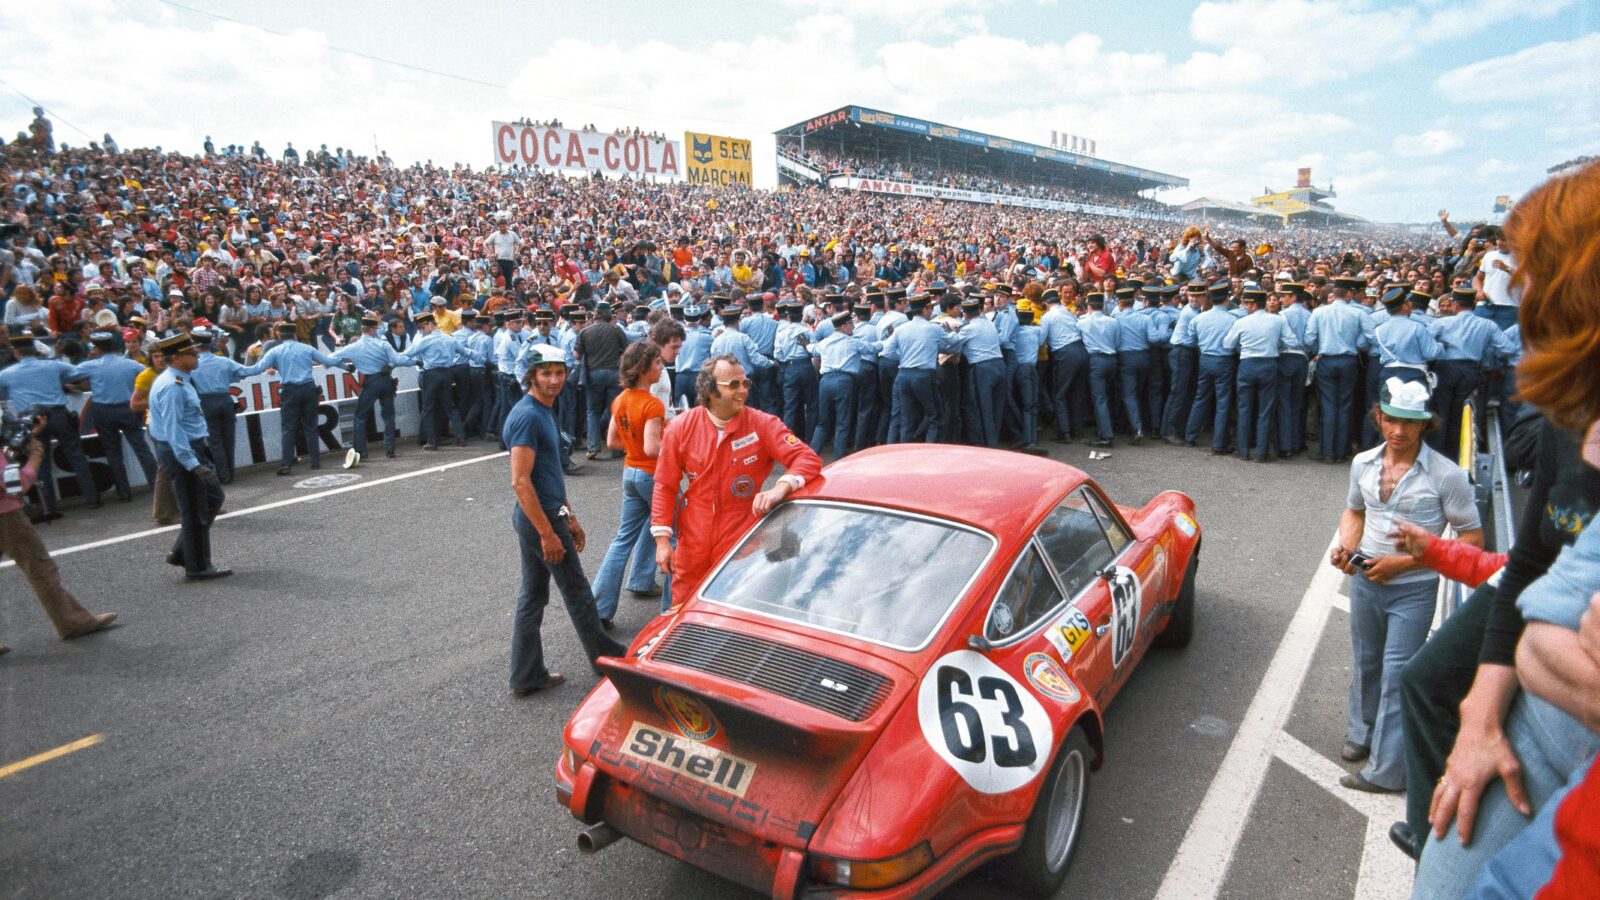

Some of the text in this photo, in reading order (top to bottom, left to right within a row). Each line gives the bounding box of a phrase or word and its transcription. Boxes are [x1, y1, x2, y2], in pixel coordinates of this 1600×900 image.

[805, 110, 847, 131] ANTAR
[497, 124, 679, 175] COCA-COLA
[859, 180, 913, 194] ANTAR
[915, 187, 972, 199] motraphite
[1060, 611, 1089, 646] GTS
[937, 665, 1037, 768] 63
[630, 727, 747, 790] Shell
